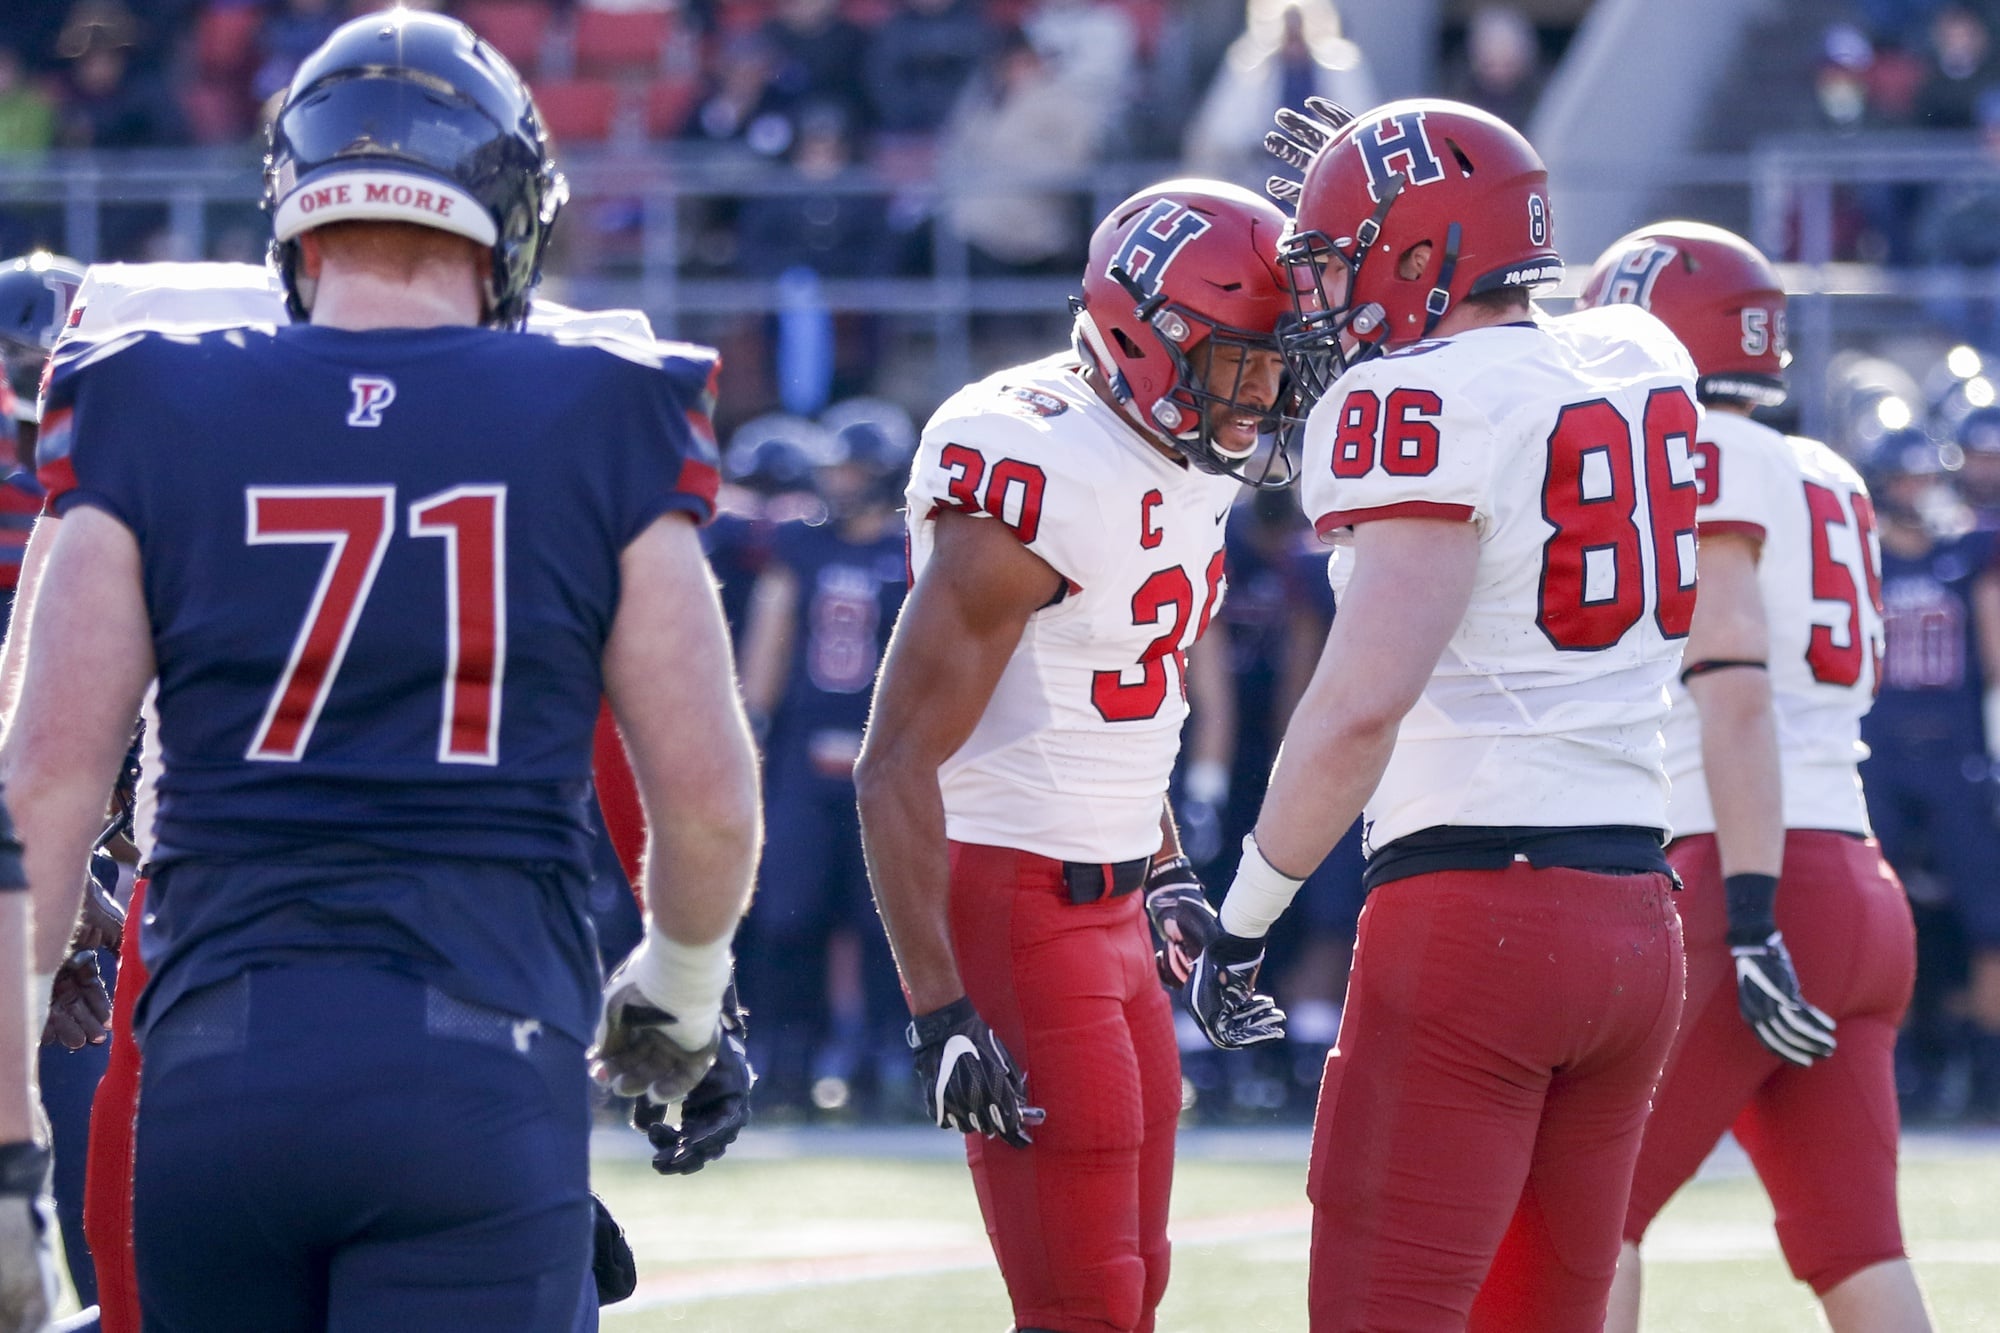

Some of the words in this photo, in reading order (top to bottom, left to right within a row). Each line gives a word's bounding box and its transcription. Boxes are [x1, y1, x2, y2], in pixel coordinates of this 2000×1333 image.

[299, 184, 351, 214] ONE
[363, 183, 455, 218] MORE
[1351, 110, 1445, 203] H
[1104, 197, 1211, 299] H
[349, 376, 396, 427] P
[1330, 387, 1443, 479] 86
[932, 442, 1047, 545] 30
[1140, 488, 1164, 550] C
[1535, 386, 1698, 651] 86
[245, 484, 507, 767] 71
